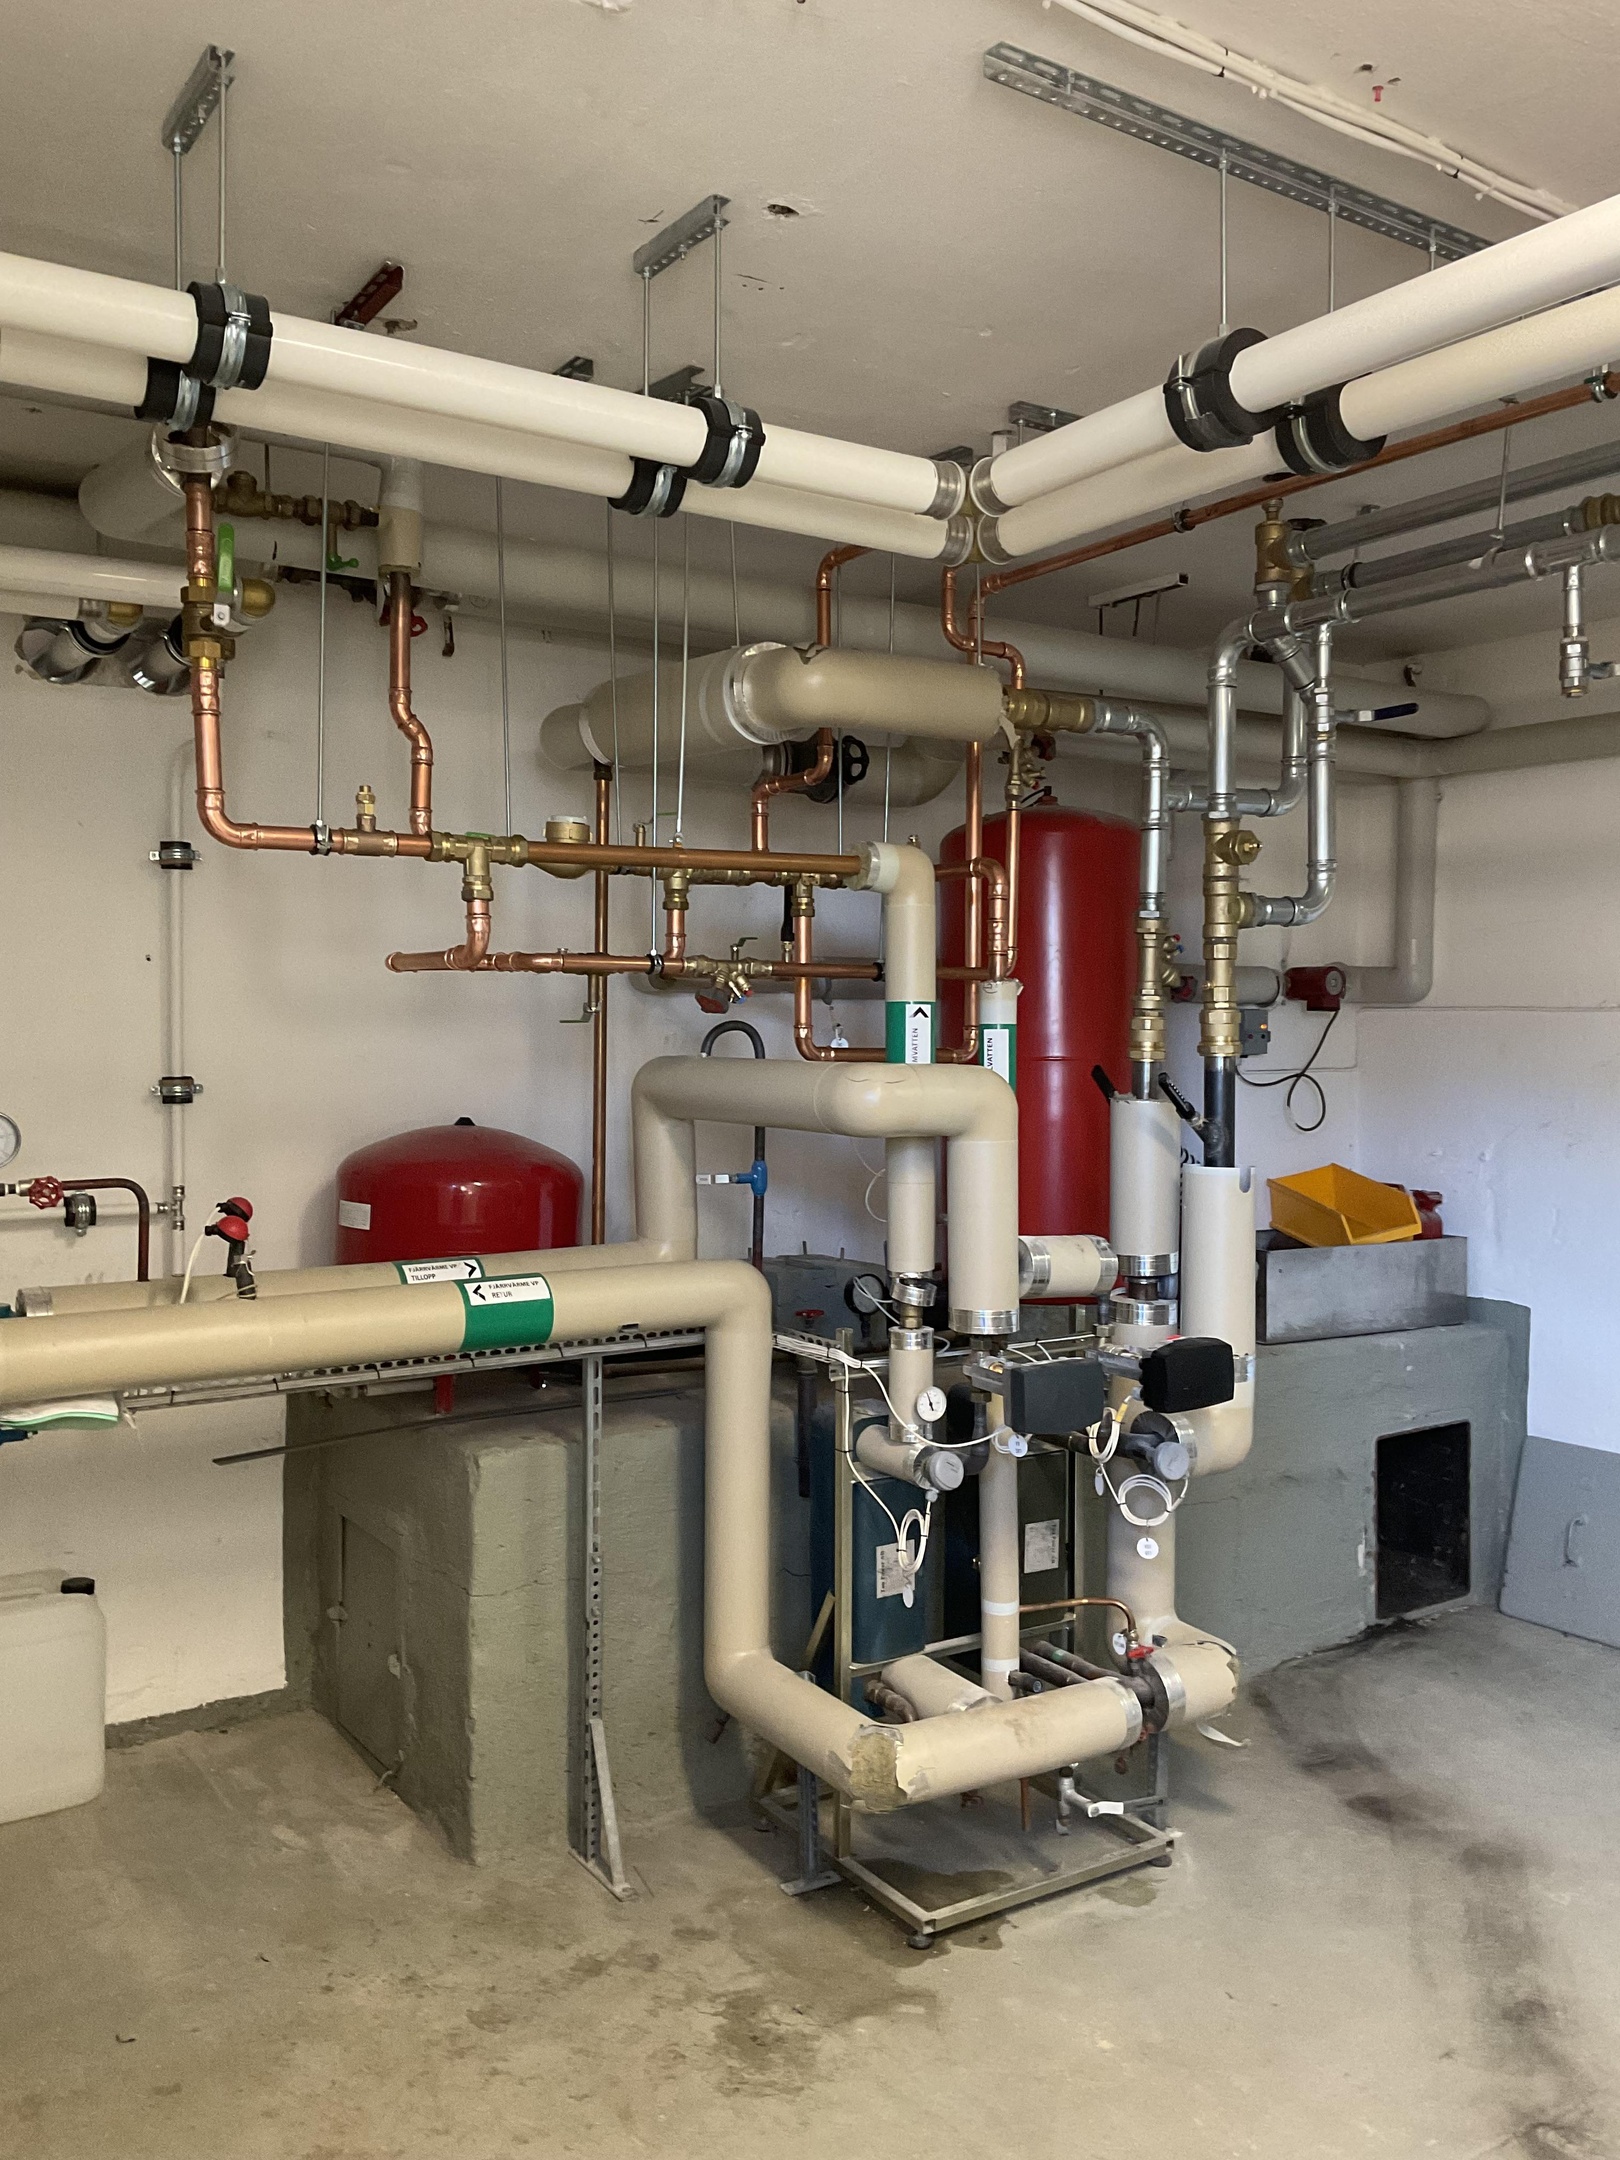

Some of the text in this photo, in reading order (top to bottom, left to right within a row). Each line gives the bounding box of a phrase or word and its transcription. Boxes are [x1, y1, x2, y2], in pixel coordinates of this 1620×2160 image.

[408, 1264, 449, 1273] FJÄRRVÄRME
[411, 1273, 436, 1281] TILLOPP
[488, 1281, 531, 1290] FJÄRRVÄRME
[491, 1291, 513, 1299] RETUR
